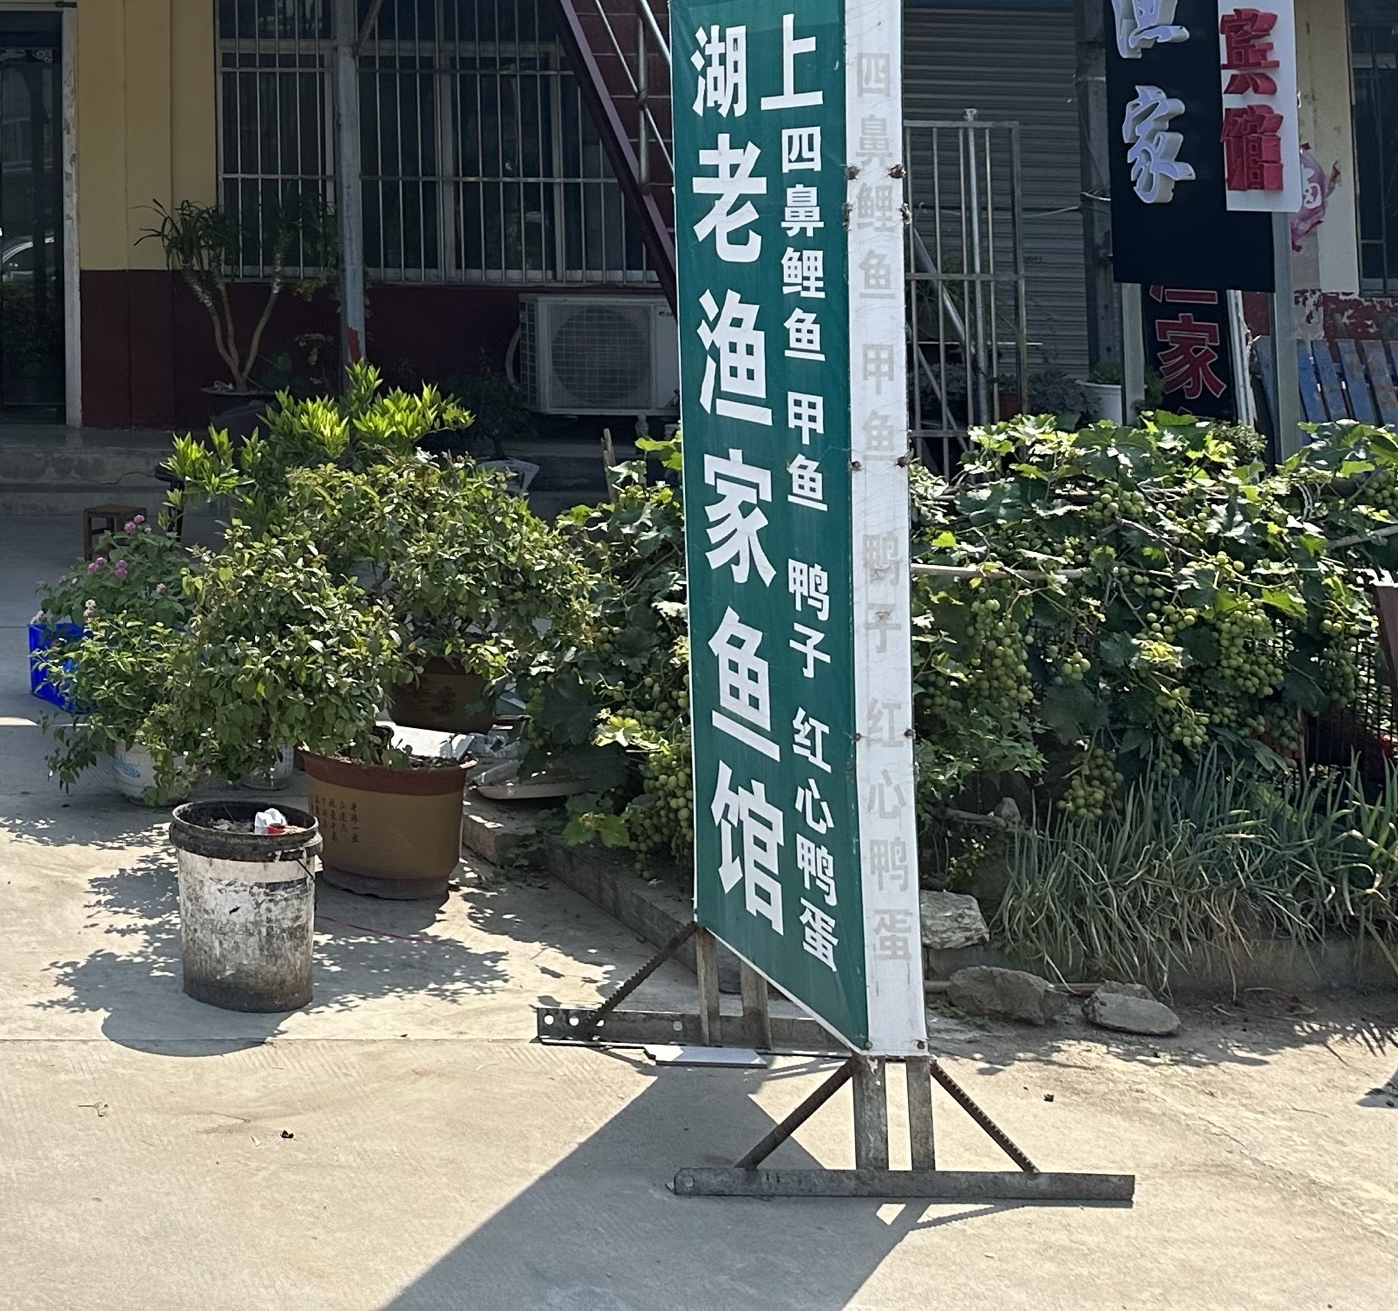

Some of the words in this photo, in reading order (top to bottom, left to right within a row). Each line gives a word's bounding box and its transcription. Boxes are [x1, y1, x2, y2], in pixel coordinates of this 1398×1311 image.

[781, 126, 826, 361] 四鼻鲤鱼
[786, 391, 828, 512] 甲鱼
[788, 558, 831, 679] 鸭子
[792, 706, 839, 972] 红心鸭蛋
